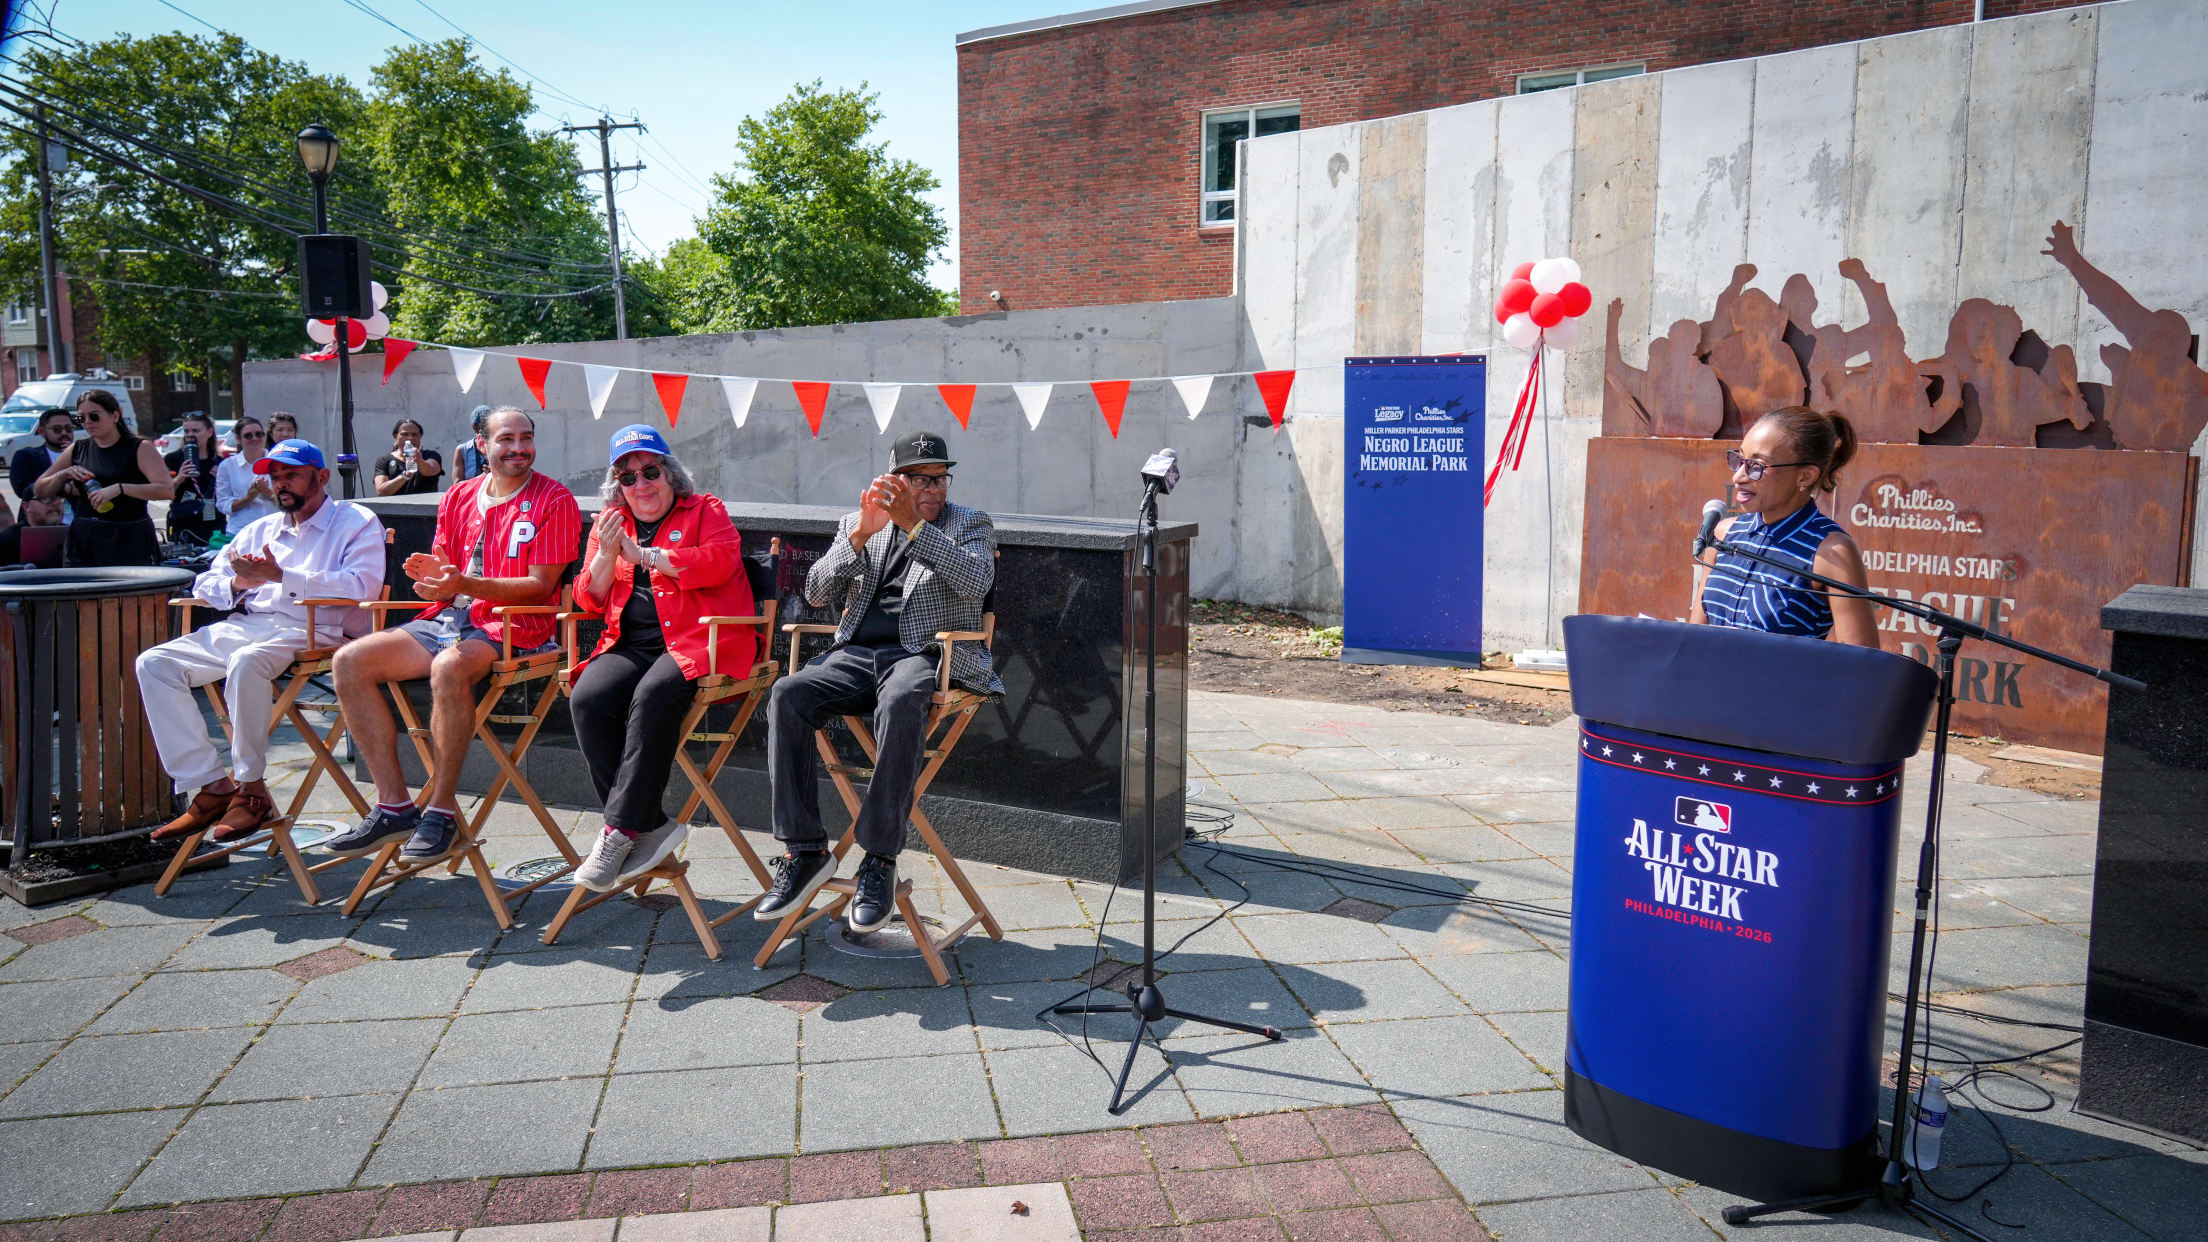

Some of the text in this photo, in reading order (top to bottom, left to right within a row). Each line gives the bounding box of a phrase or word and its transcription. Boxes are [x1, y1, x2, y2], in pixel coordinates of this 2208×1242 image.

[1375, 408, 1404, 420] Legacy
[1364, 436, 1464, 453] NEGRO LEAGUE
[1360, 454, 1468, 471] MEMORIAL PARK
[1877, 484, 1955, 511] Phillies
[507, 520, 537, 558] P
[1861, 550, 2017, 582] ADELPHIA STARS
[1868, 586, 2016, 640] EAGUE
[1624, 818, 1779, 888] ALL STAR
[1644, 861, 1744, 922] WEEK
[1625, 898, 1773, 944] PHILADELPHIA 2026
